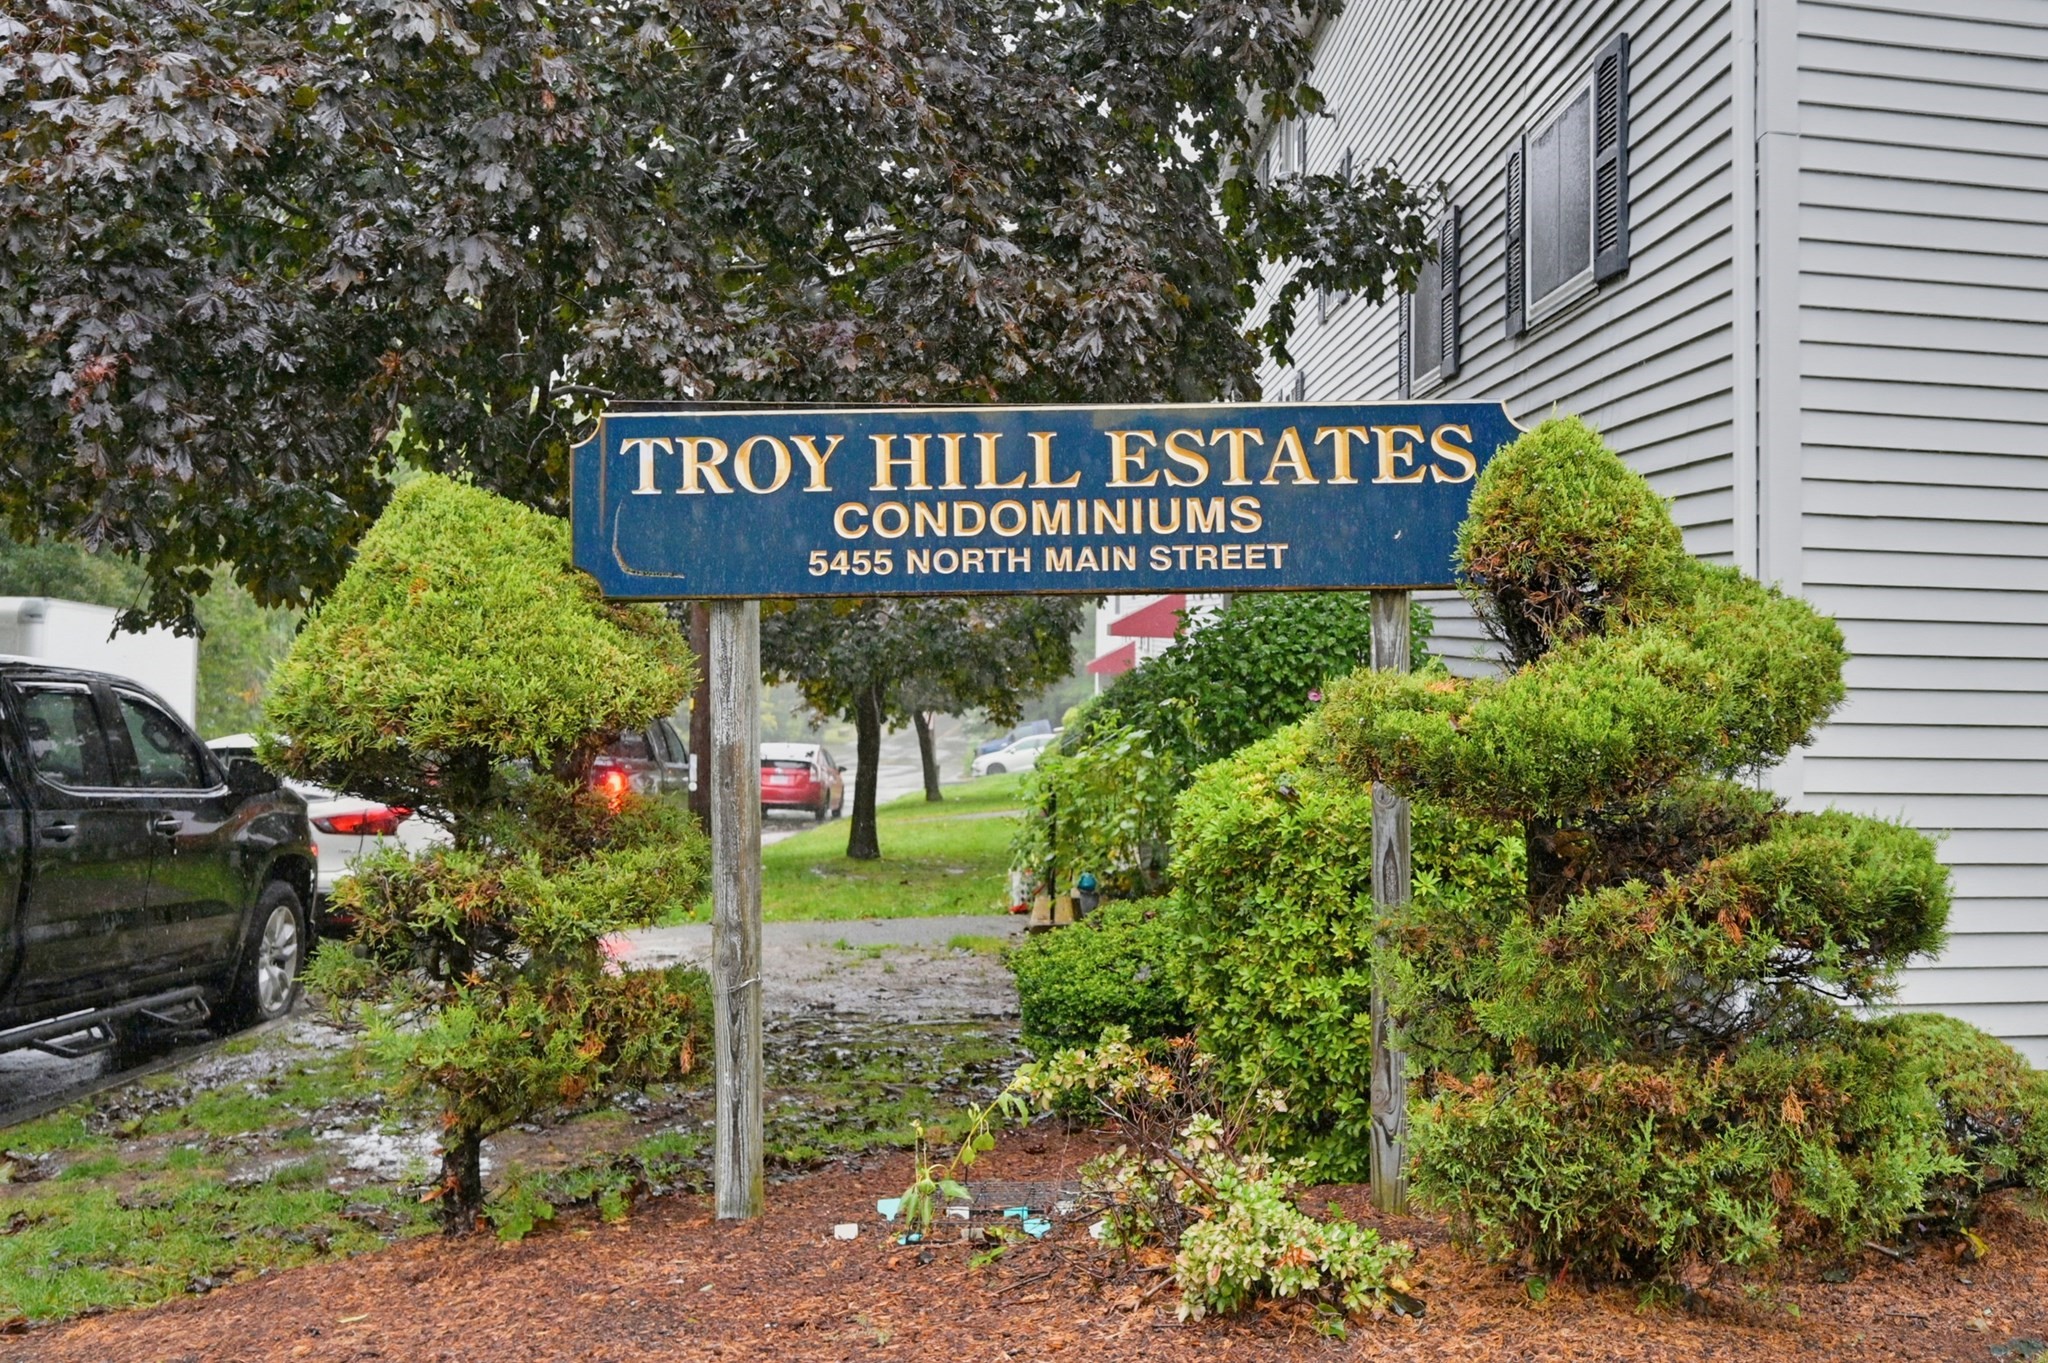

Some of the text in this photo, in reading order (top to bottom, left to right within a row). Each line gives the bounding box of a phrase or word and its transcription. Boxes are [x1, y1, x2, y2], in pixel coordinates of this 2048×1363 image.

[619, 424, 1477, 495] TROY HILL ESTATES
[833, 495, 1263, 540] CONDOMINIUMS
[808, 543, 1289, 576] 5455 NORTH MAIN STREET
